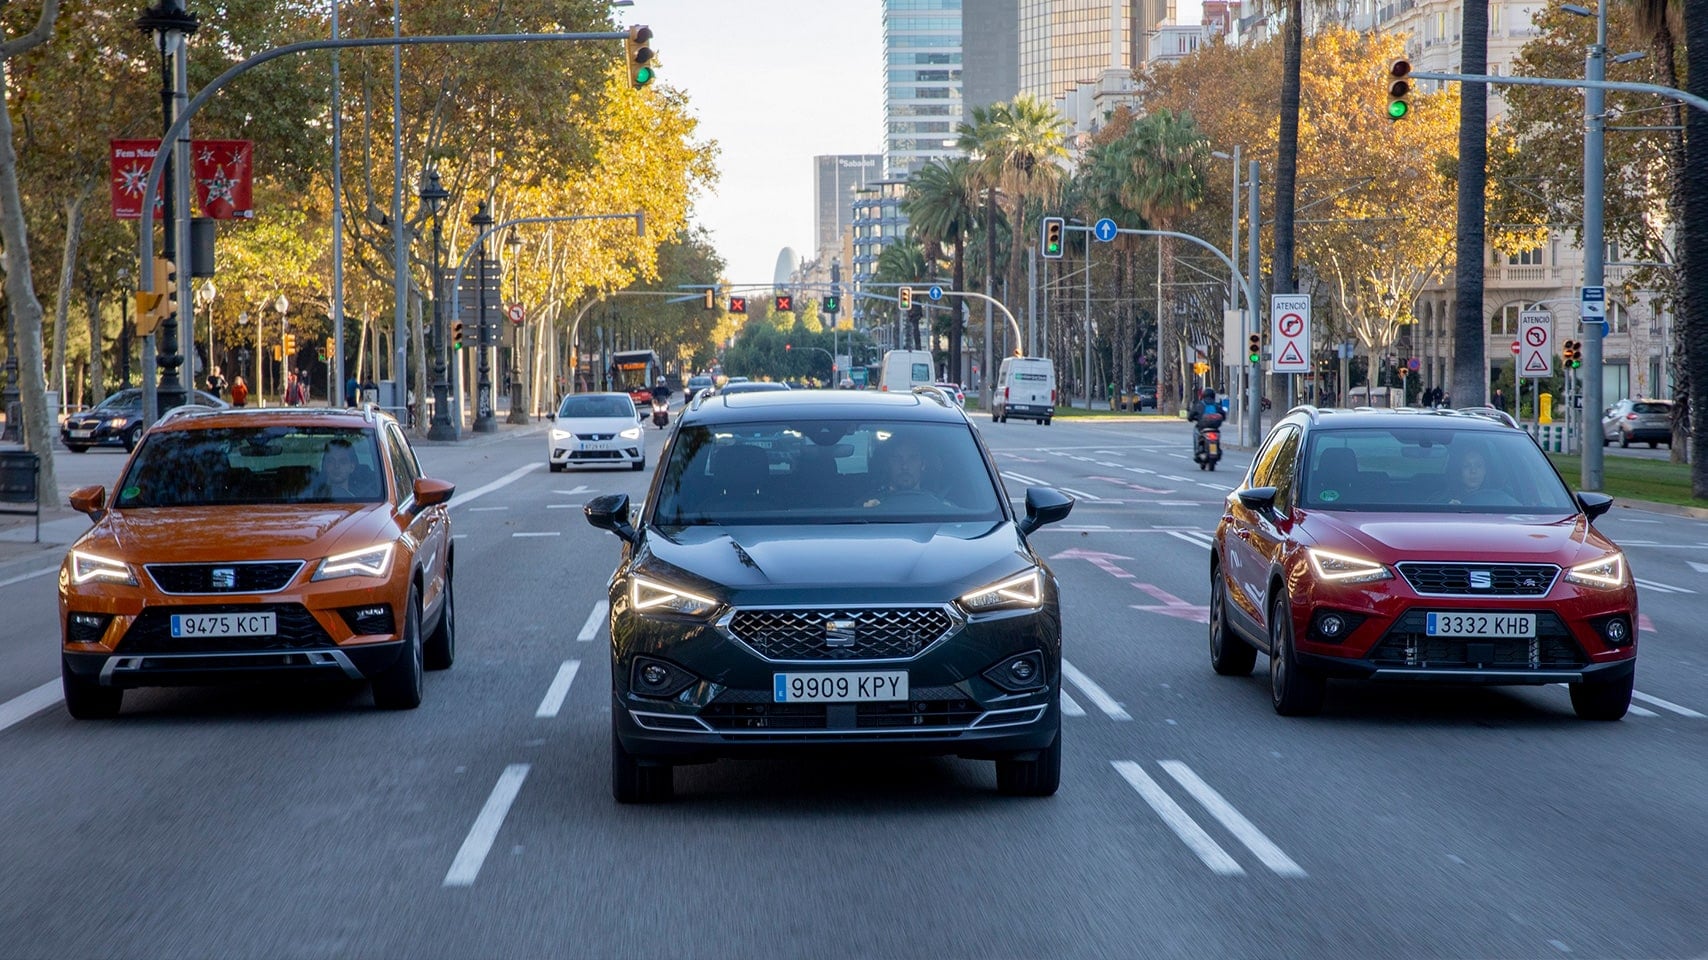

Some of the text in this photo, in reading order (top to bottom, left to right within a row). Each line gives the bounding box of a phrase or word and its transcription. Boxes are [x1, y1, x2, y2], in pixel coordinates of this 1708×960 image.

[115, 148, 135, 158] Fem
[843, 159, 875, 168] Sabadell
[1276, 301, 1307, 310] ATENCIÓ
[1522, 315, 1550, 324] ATENCIÓ
[185, 616, 270, 634] 9475 KCT
[1440, 616, 1488, 634] 3332
[1494, 617, 1529, 634] KHB
[791, 677, 849, 698] 9909
[858, 676, 900, 697] KPY
